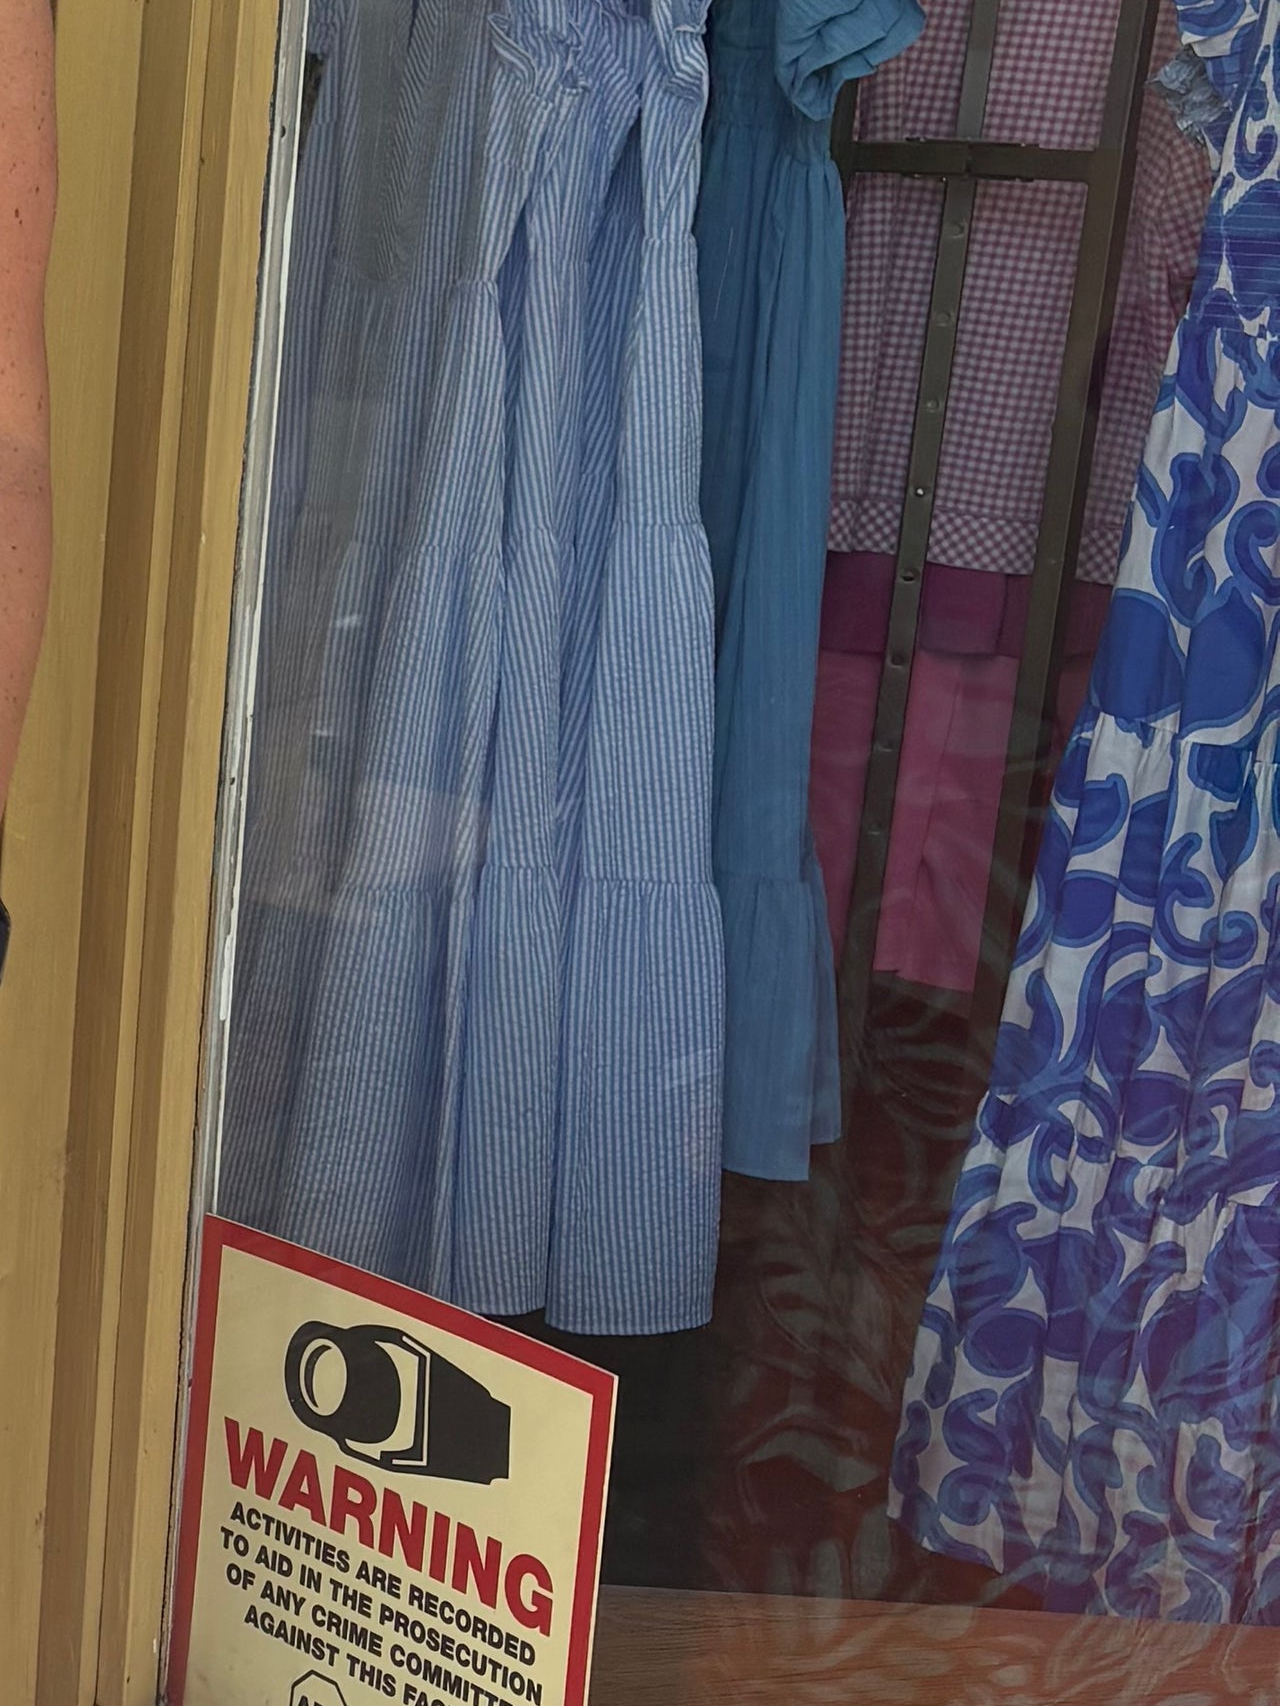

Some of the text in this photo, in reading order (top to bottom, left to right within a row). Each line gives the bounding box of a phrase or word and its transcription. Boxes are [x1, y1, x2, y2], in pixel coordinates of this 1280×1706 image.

[224, 1416, 554, 1637] WARNING
[230, 1501, 536, 1667] ACTIVITIES ARE RECORDED
[220, 1526, 543, 1706] TO AID IN THE PROSECUTION
[226, 1563, 256, 1591] OF
[260, 1580, 306, 1617] ANY
[311, 1604, 384, 1658] CRIME
[244, 1604, 340, 1667] AGAINST
[346, 1653, 397, 1698] THIS
